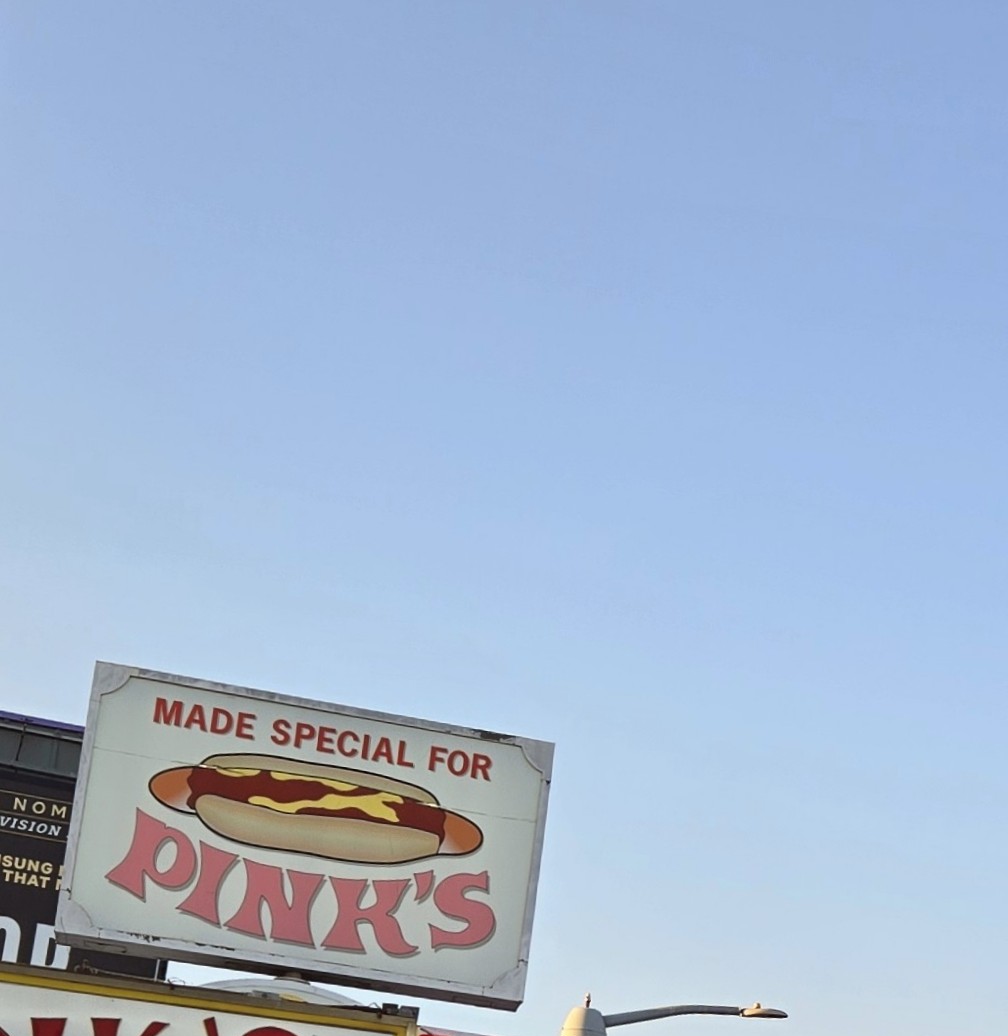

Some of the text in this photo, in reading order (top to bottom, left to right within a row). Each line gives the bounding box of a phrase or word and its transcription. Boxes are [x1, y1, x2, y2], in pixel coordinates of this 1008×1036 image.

[152, 697, 493, 782] MADE SPECIAL FOR
[13, 797, 67, 819] NOM
[0, 854, 53, 875] SUNG
[3, 869, 51, 889] THAT
[105, 806, 497, 957] PINK'S
